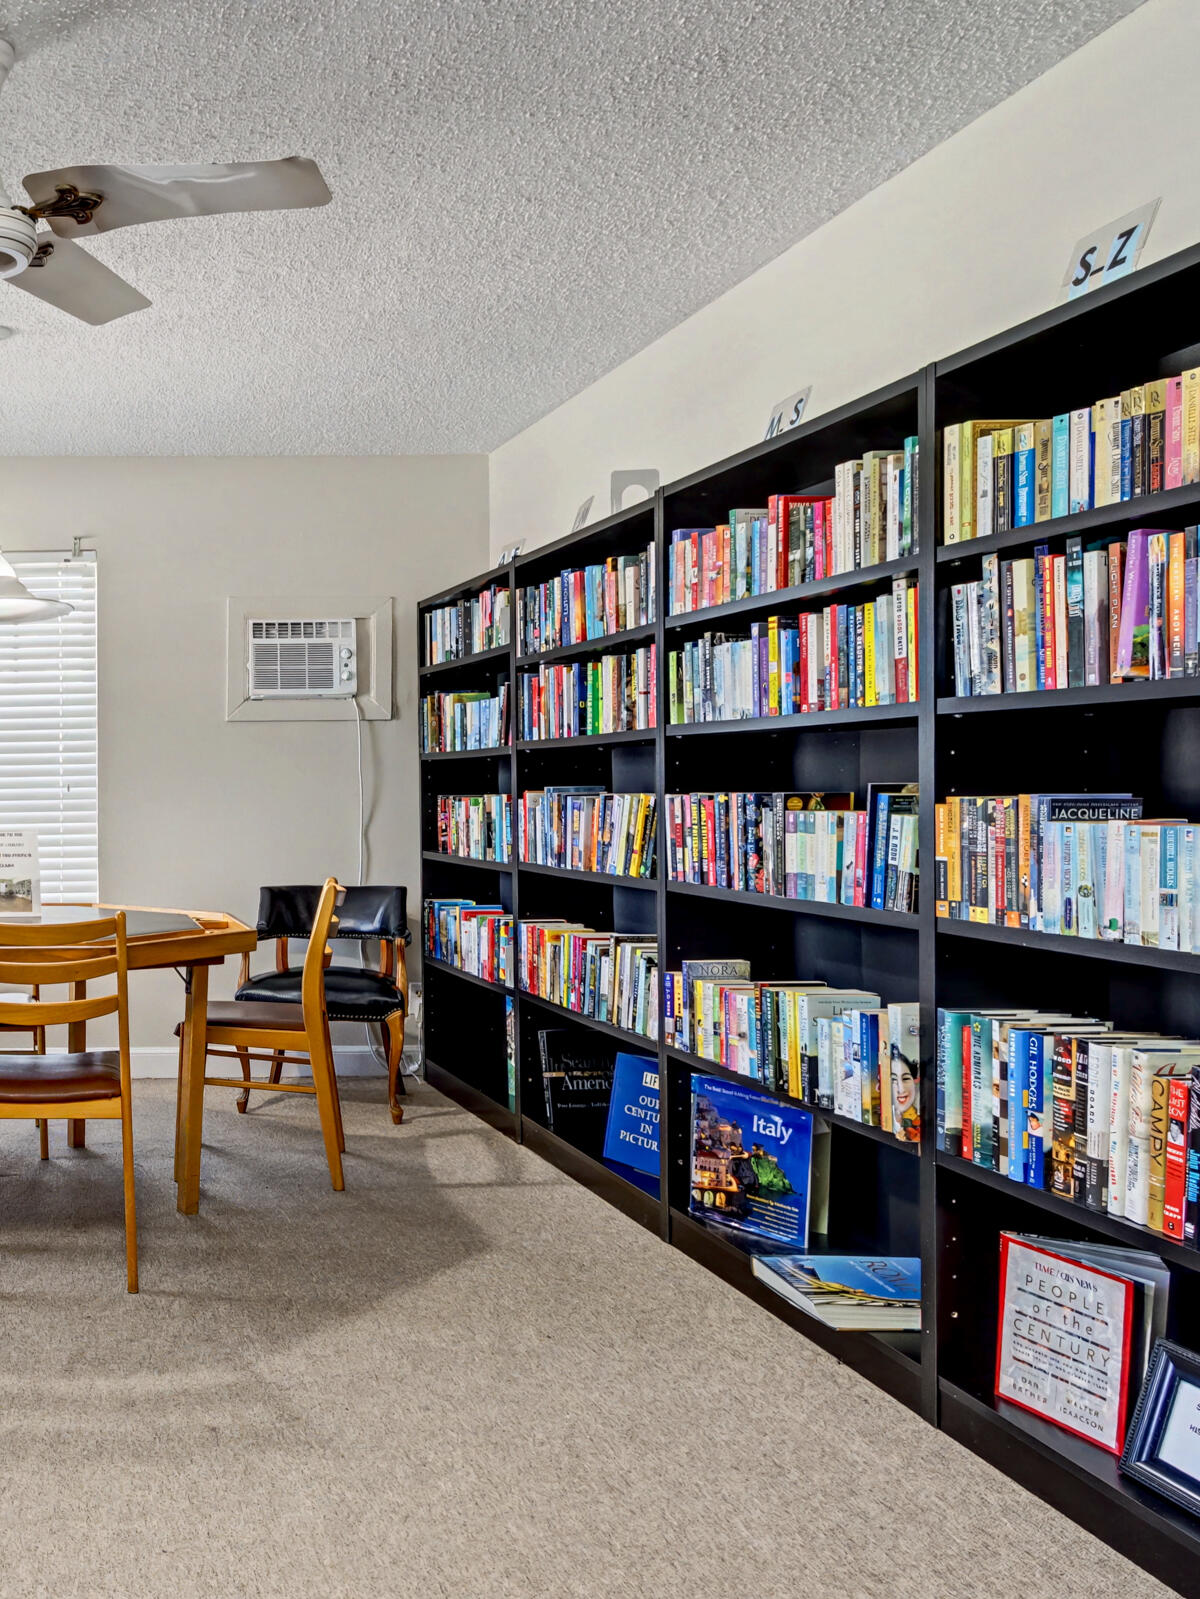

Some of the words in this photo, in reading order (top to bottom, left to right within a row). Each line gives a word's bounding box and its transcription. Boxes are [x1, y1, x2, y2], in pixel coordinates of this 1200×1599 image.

[1110, 556, 1118, 595] FLIGHT
[1051, 809, 1139, 821] JACQUELINE
[699, 995, 739, 1006] NORA
[1029, 1037, 1038, 1057] GIL
[562, 1074, 613, 1091] Americ
[973, 1050, 982, 1090] ADMIRALS
[1028, 1060, 1037, 1110] HODGES
[624, 1104, 661, 1123] CENTU
[1150, 1080, 1165, 1167] CAMPY
[619, 1129, 661, 1153] PICTUR
[640, 1122, 653, 1135] IN
[751, 1114, 793, 1145] Italy
[1189, 1149, 1200, 1170] John
[1187, 1170, 1200, 1202] Madden
[1034, 1261, 1055, 1277] TIME
[1075, 1277, 1098, 1293] NEWS
[1024, 1274, 1106, 1316] PEOPLE
[1032, 1303, 1051, 1317] of
[1062, 1314, 1094, 1336] the
[1013, 1318, 1112, 1368] CENTURY
[1021, 1376, 1040, 1391] DAN
[1059, 1405, 1105, 1433] ISAACSON
[1064, 1397, 1100, 1418] WALTER
